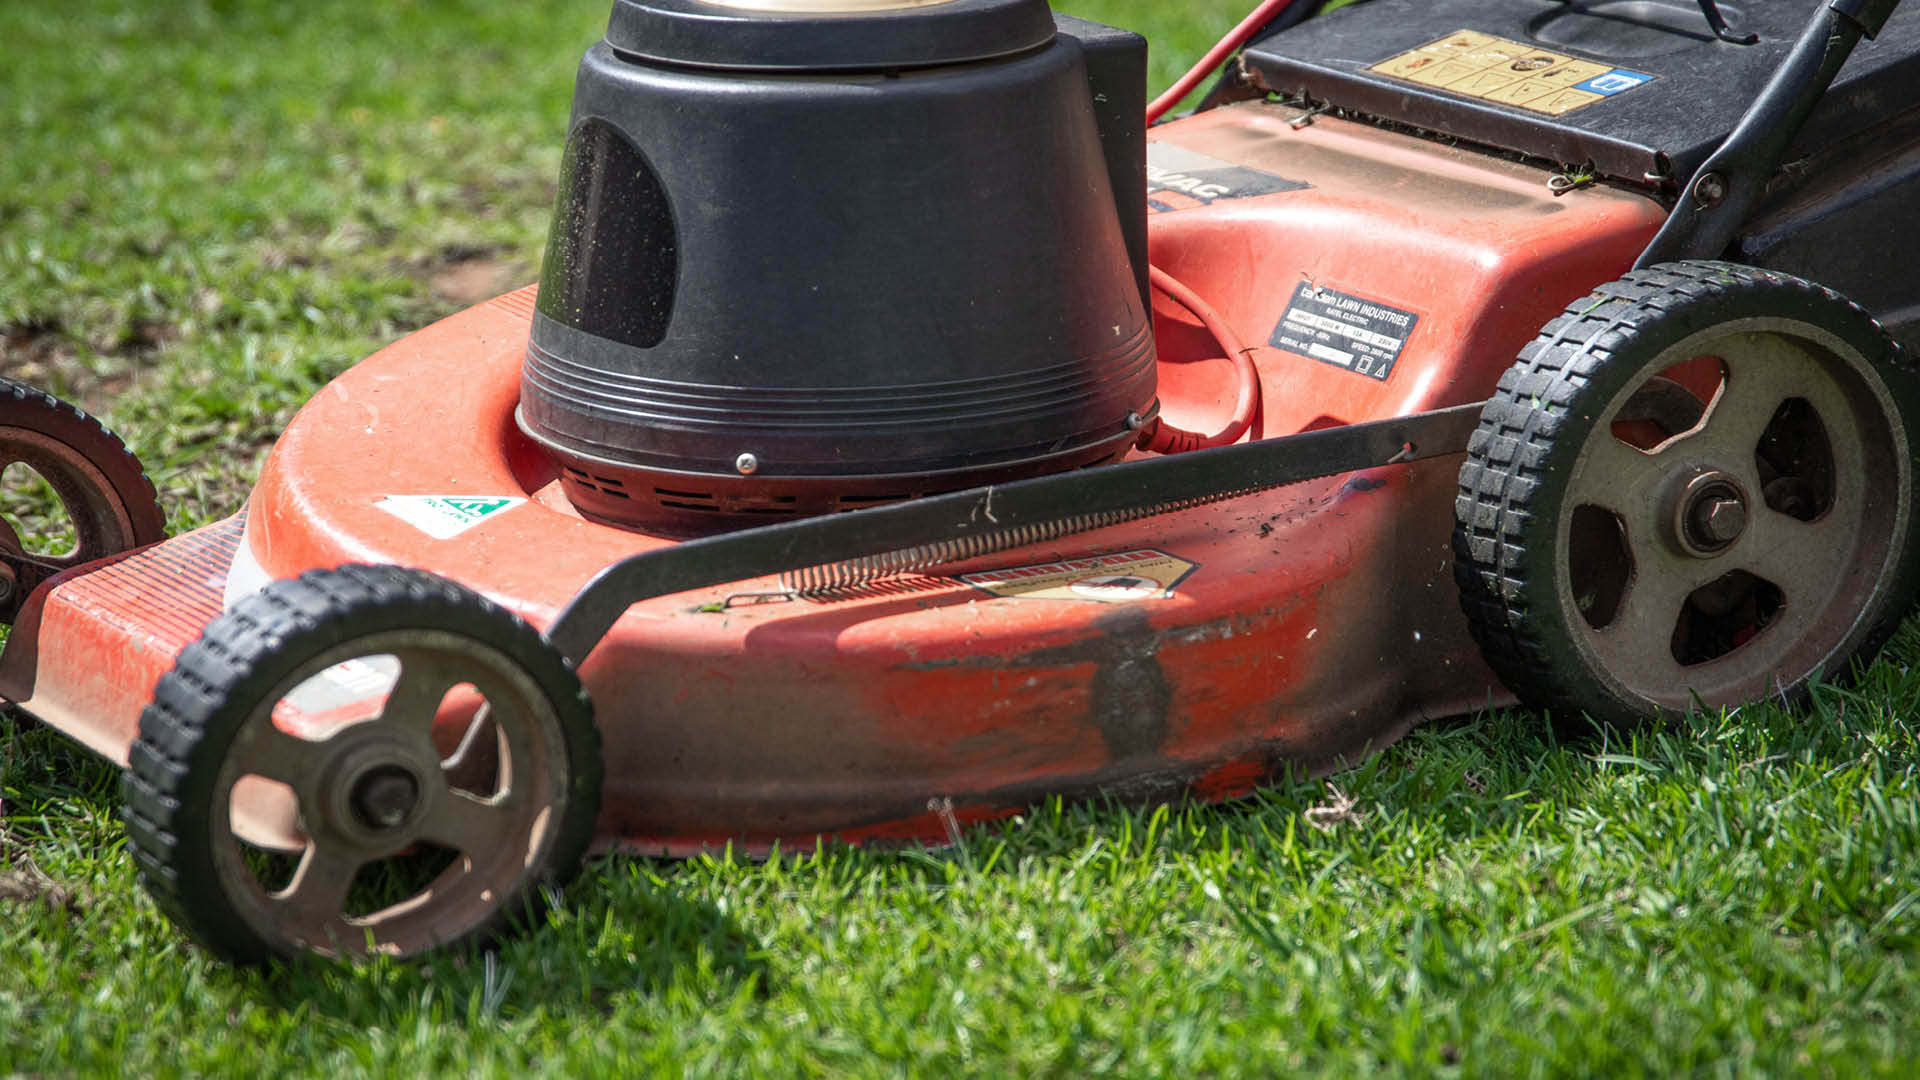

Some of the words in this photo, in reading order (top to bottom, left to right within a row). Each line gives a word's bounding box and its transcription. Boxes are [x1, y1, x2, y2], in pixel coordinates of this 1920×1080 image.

[1147, 166, 1230, 198] VAC
[1336, 298, 1361, 313] LAWN
[1360, 304, 1409, 327] INDUSTRIES
[1342, 312, 1369, 325] ELECTRIC
